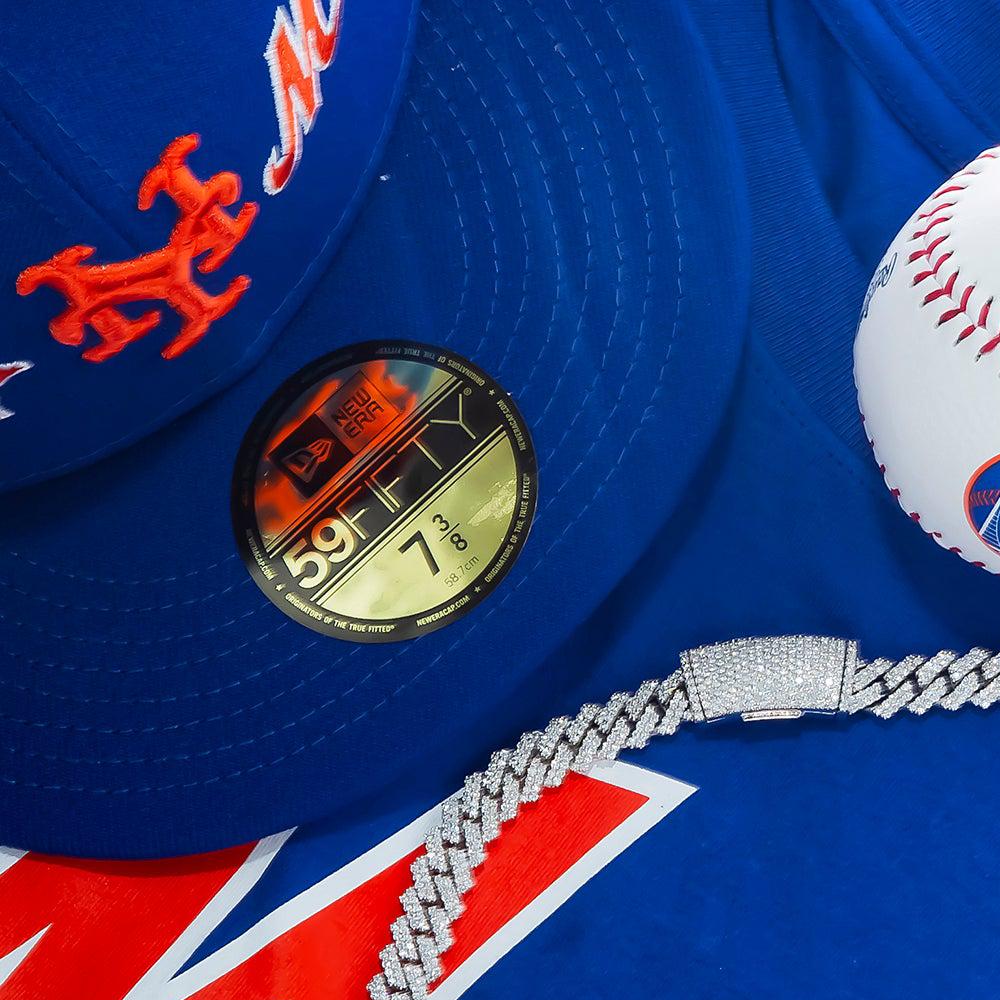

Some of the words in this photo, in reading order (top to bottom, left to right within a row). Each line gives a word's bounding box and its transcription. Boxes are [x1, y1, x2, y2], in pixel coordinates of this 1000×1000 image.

[437, 355, 447, 364] OF
[448, 359, 486, 387] ORIGINATORS
[519, 501, 529, 518] TRUE
[511, 534, 519, 544] OF
[515, 521, 524, 534] THE
[398, 530, 440, 577] 7
[485, 544, 515, 582] ORIGINATORS
[444, 555, 480, 588] 58.7cm
[285, 593, 323, 621] ORIGINATORS
[323, 616, 333, 624] OF
[333, 619, 347, 629] THE
[349, 623, 366, 632] TRUE
[416, 595, 471, 627] NEWERACAP.COM
